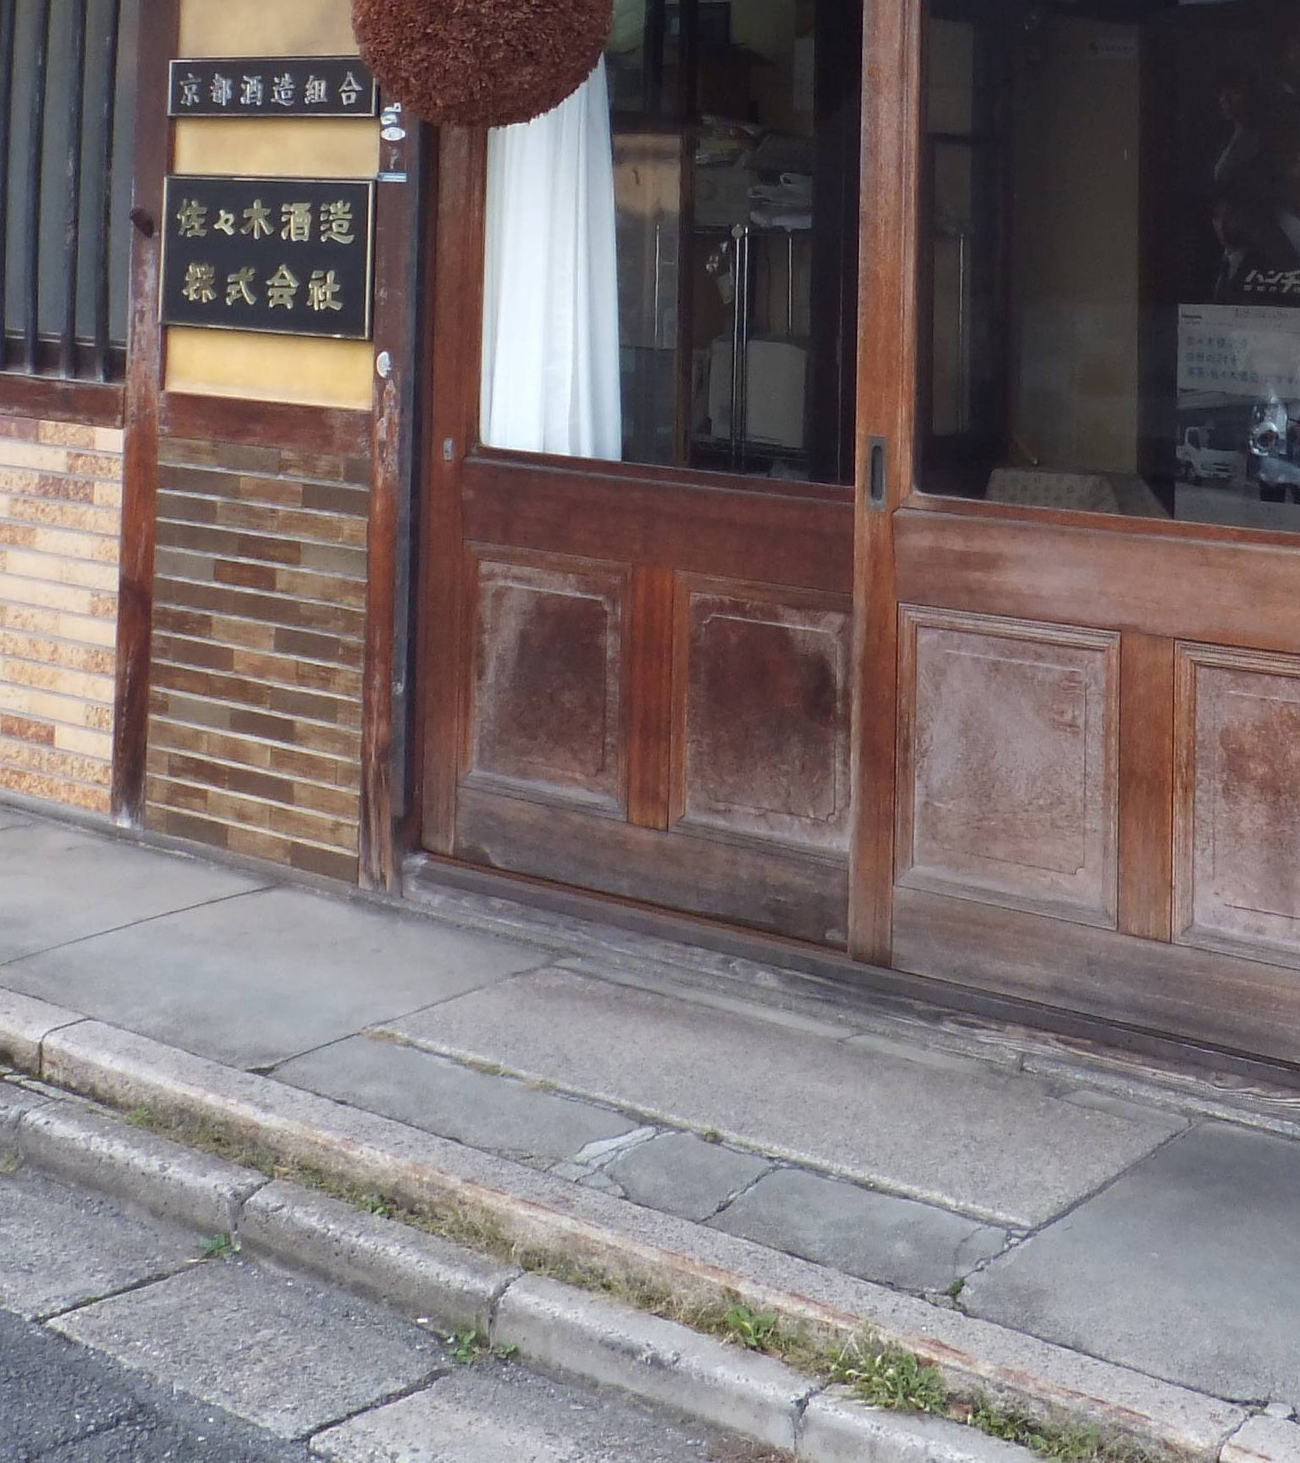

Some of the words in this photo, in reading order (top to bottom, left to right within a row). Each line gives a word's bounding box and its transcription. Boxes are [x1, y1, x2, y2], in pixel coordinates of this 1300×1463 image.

[179, 71, 364, 107] 京都酒造組合
[176, 197, 356, 245] 佐々木酒造
[181, 260, 345, 312] 株式会社
